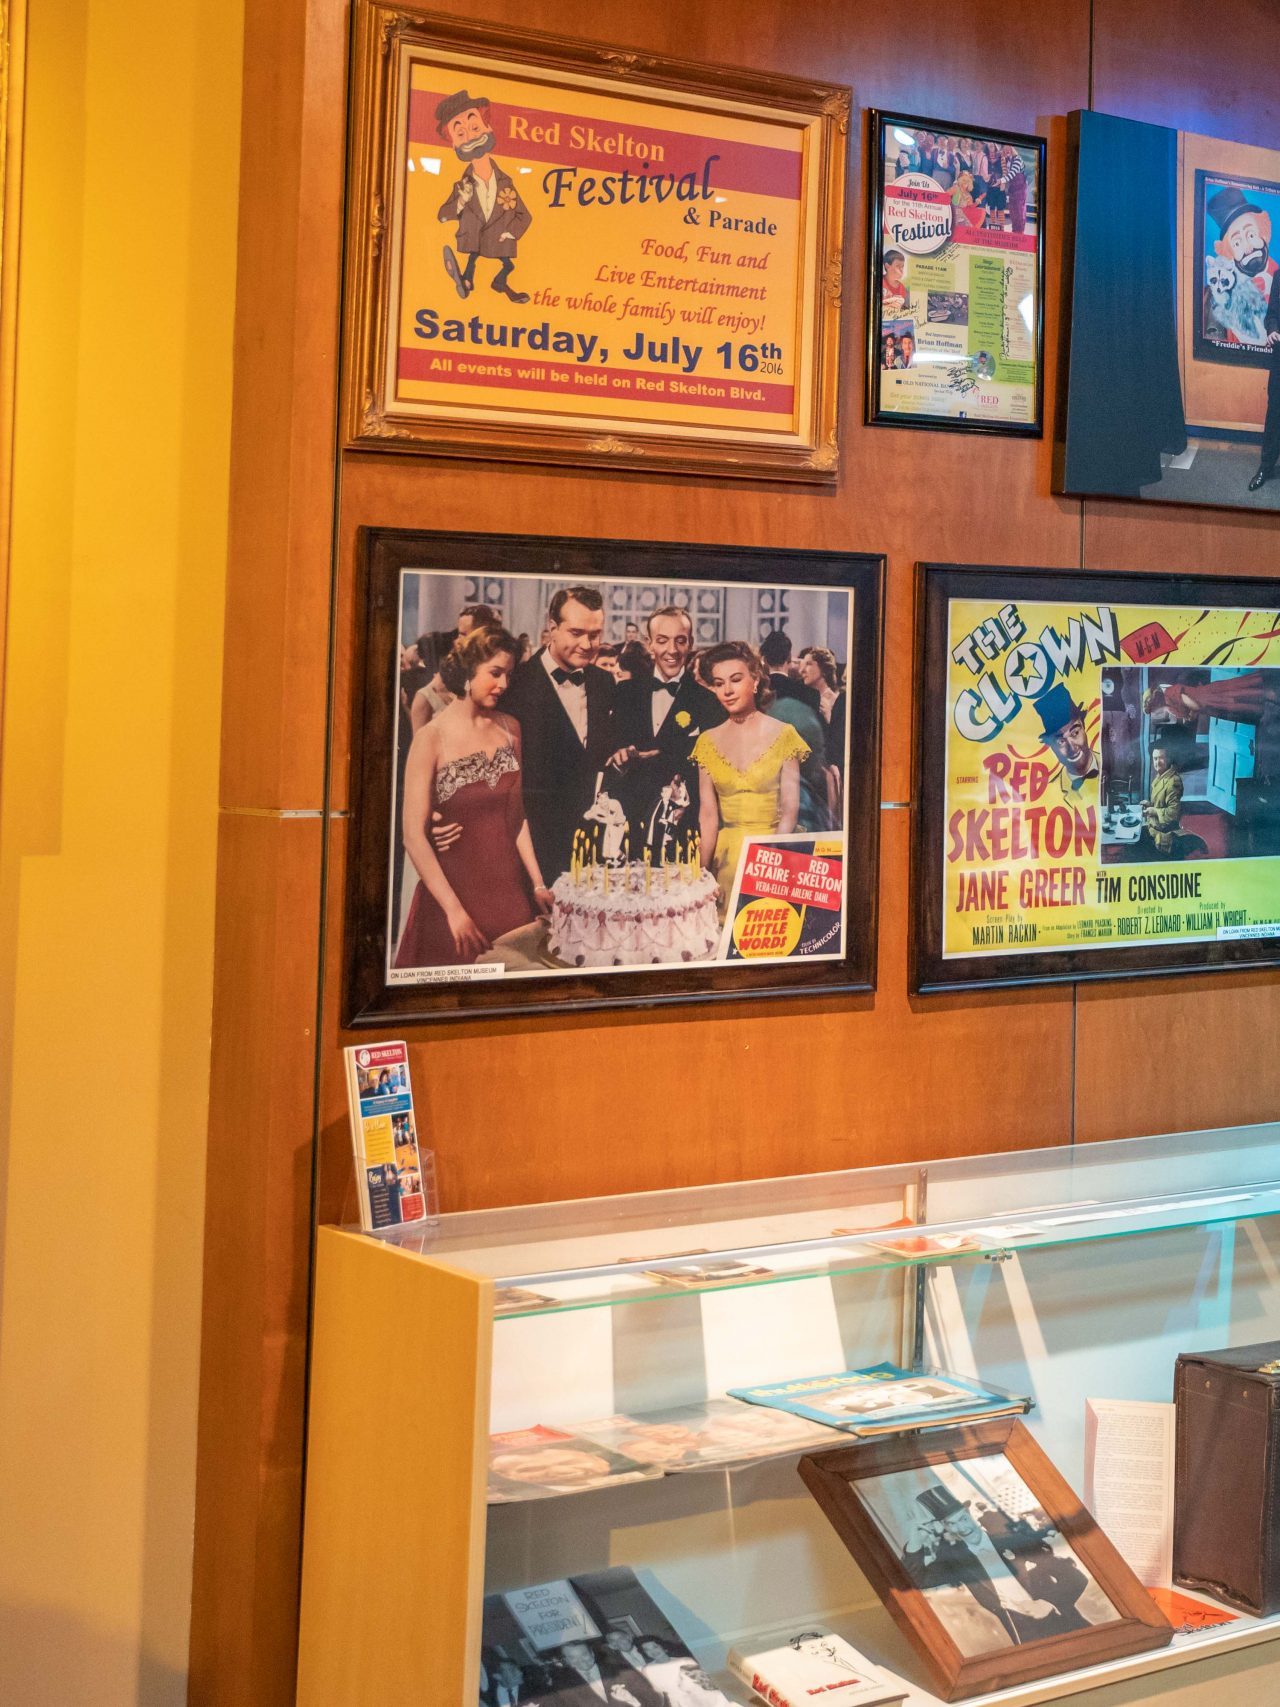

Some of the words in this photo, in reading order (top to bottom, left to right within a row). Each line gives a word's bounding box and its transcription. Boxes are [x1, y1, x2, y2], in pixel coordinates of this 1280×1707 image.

[508, 115, 560, 146] Red
[569, 124, 666, 162] Skelton
[542, 155, 721, 209] Festival
[898, 187, 919, 201] July
[908, 179, 921, 188] Join
[921, 181, 930, 189] Us
[683, 207, 701, 226] &
[708, 211, 778, 237] Parade
[888, 205, 908, 218] Red
[908, 208, 944, 223] Skelton
[891, 218, 951, 243] Festival
[641, 238, 690, 264] Food,
[696, 246, 732, 265] Fun
[736, 252, 769, 270] and
[594, 265, 635, 285] Live
[641, 270, 767, 301] Entertainment
[533, 288, 561, 307] the
[565, 292, 616, 314] whole
[617, 297, 676, 326] family
[680, 306, 713, 326] will
[717, 314, 766, 334] enjoy!
[413, 308, 609, 365] Saturday,
[623, 332, 703, 373] July
[917, 338, 935, 346] Brian
[936, 340, 963, 349] Hoffman
[429, 357, 453, 373] All
[456, 361, 513, 379] events
[517, 366, 546, 382] will
[549, 369, 570, 384] be
[574, 371, 608, 388] held
[612, 377, 632, 390] on
[635, 377, 665, 393] Red
[668, 379, 727, 398] Skelton
[729, 385, 766, 402] Blvd.
[760, 360, 784, 375] 2016
[980, 394, 999, 405] RED
[952, 604, 1028, 675] THE
[954, 606, 1122, 743] CLOWN
[956, 774, 979, 785] STARRING
[982, 751, 1052, 806] RED
[947, 804, 1098, 864] SKELTON
[755, 849, 783, 867] FRED
[808, 859, 830, 876] RED
[744, 862, 791, 884] ASTAIRE
[797, 871, 842, 893] SKELTON
[955, 869, 1009, 913] JANE
[1019, 867, 1086, 909] GREER
[1096, 876, 1122, 904] TIM
[1128, 872, 1202, 902] CONSIDINE
[755, 881, 789, 896] VERA-ELLEN
[790, 885, 813, 902] ARLENE
[813, 890, 829, 904] DAHL
[746, 907, 791, 923] THREE
[1005, 913, 1016, 924] Play
[1017, 913, 1023, 924] by
[1157, 905, 1163, 915] by
[1220, 901, 1226, 911] by
[742, 921, 789, 937] LITTLE
[800, 921, 842, 955] TECHNICOLOR
[972, 923, 1005, 946] MARTIN
[1008, 922, 1038, 944] RACKIN
[1117, 916, 1143, 937] ROBERT
[1144, 915, 1151, 935] Z.
[1151, 914, 1181, 934] LEONARD
[1185, 911, 1214, 932] WILLIAM
[1223, 909, 1247, 927] WRIGHT
[738, 936, 788, 951] WORDS
[447, 968, 472, 976] SKELTON
[515, 1594, 570, 1613] SKELTON
[524, 1588, 551, 1600] RED
[538, 1609, 561, 1620] FOR
